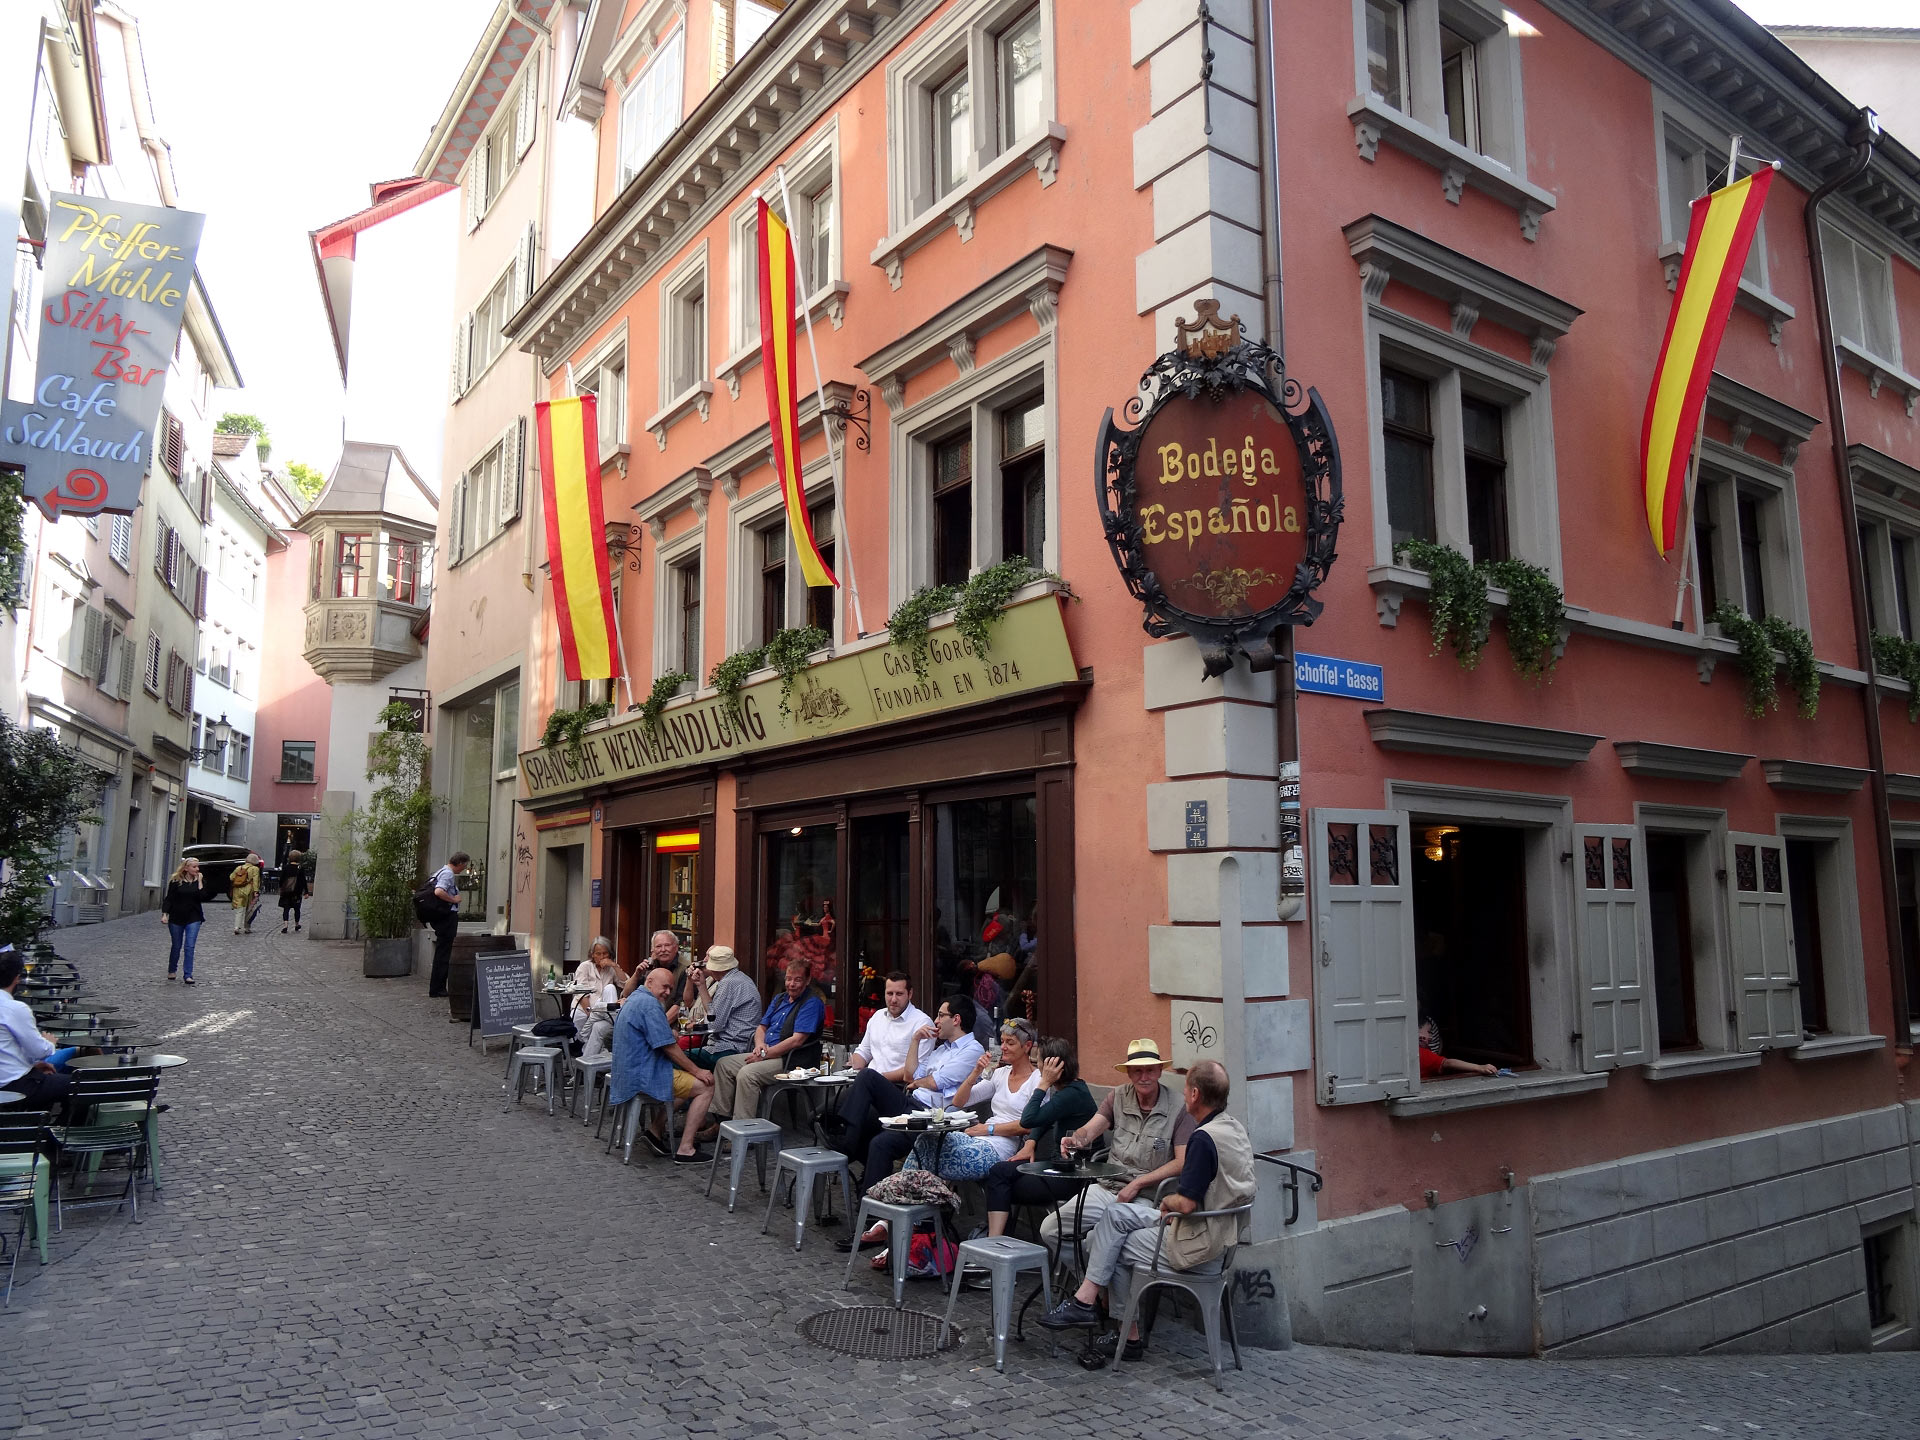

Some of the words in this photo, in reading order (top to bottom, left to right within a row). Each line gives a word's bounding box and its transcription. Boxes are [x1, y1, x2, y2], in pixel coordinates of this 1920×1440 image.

[55, 200, 185, 261] Pfeffer-
[67, 254, 182, 307] Mühle
[90, 340, 165, 387] Bar
[37, 373, 118, 420] Cafe
[5, 412, 145, 464] Schlauch
[1157, 435, 1280, 486] Bodega
[1139, 494, 1301, 552] Española
[883, 650, 924, 676] CASA
[929, 636, 993, 666] GORG
[873, 680, 943, 712] FUNDADA
[953, 672, 974, 694] EN
[985, 660, 1020, 686] 1874
[602, 695, 767, 773] WEINHANDLUNG
